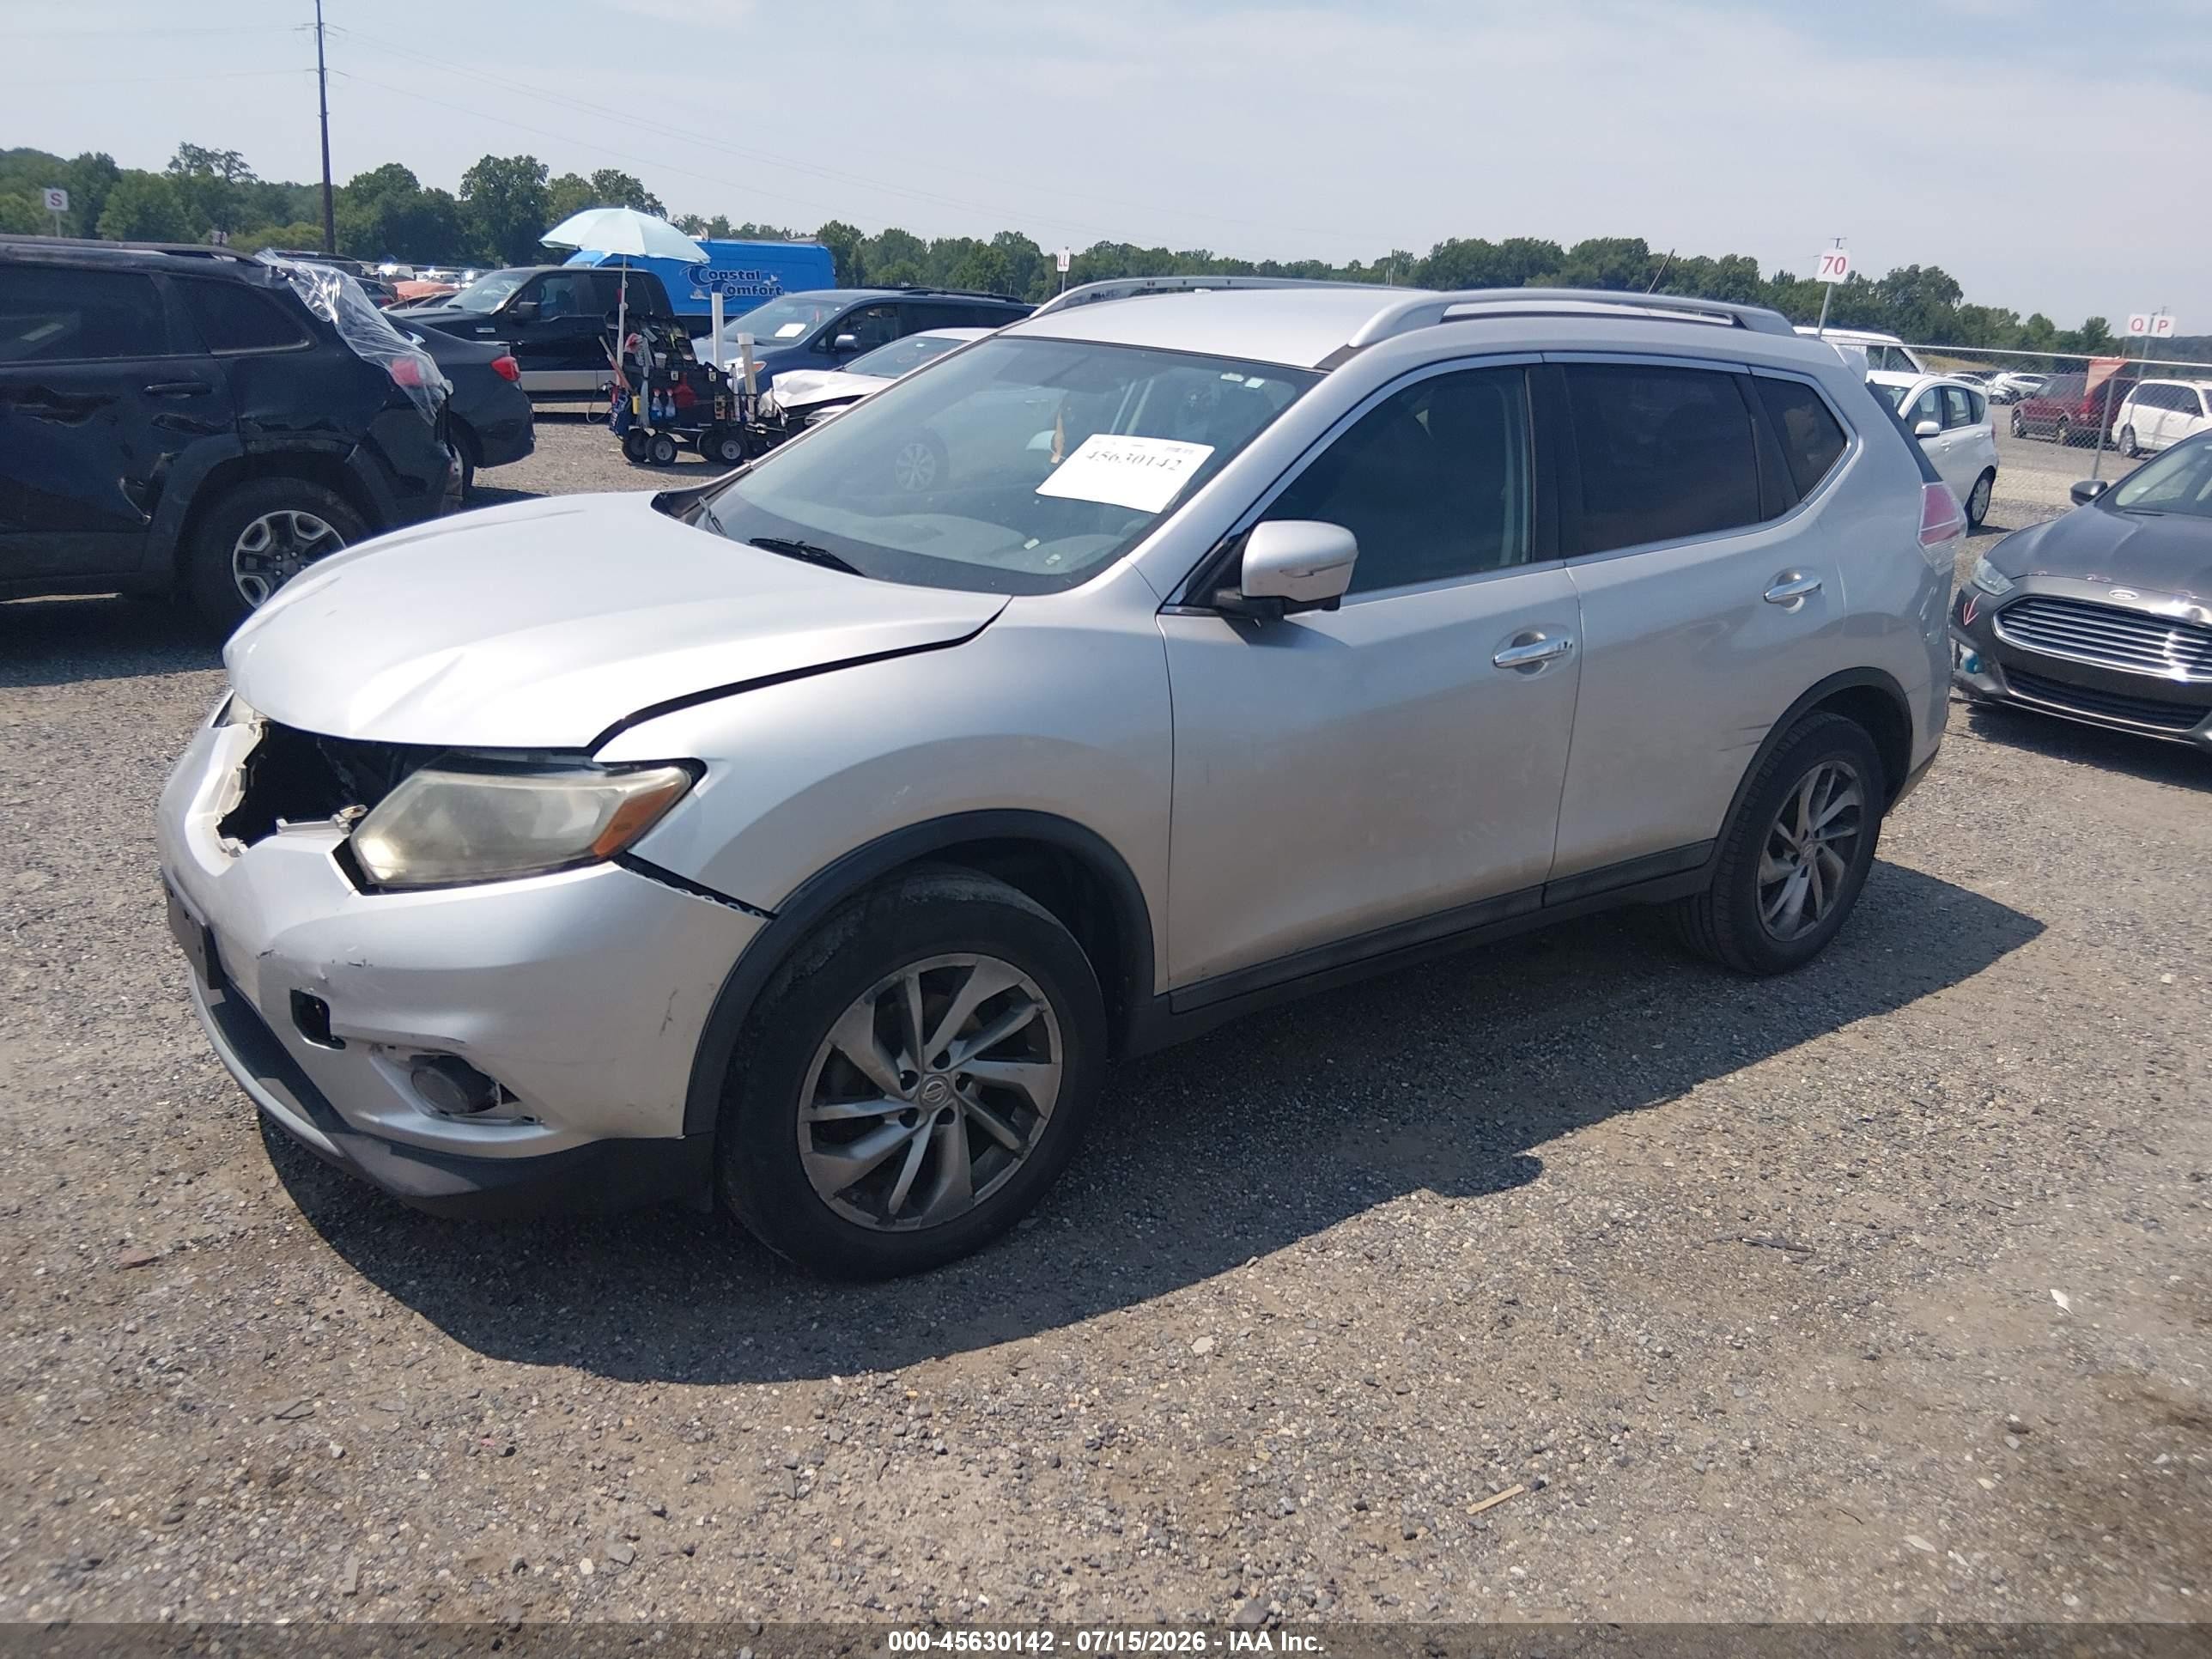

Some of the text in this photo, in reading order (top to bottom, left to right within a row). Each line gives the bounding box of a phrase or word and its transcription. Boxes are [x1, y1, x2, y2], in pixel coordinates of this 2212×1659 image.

[51, 192, 63, 207] S
[689, 264, 761, 287] Coastal
[1822, 256, 1847, 276] 70
[710, 279, 784, 301] Comfort
[2130, 318, 2144, 332] Q
[2157, 319, 2169, 333] P
[1086, 450, 1182, 471] 45630142
